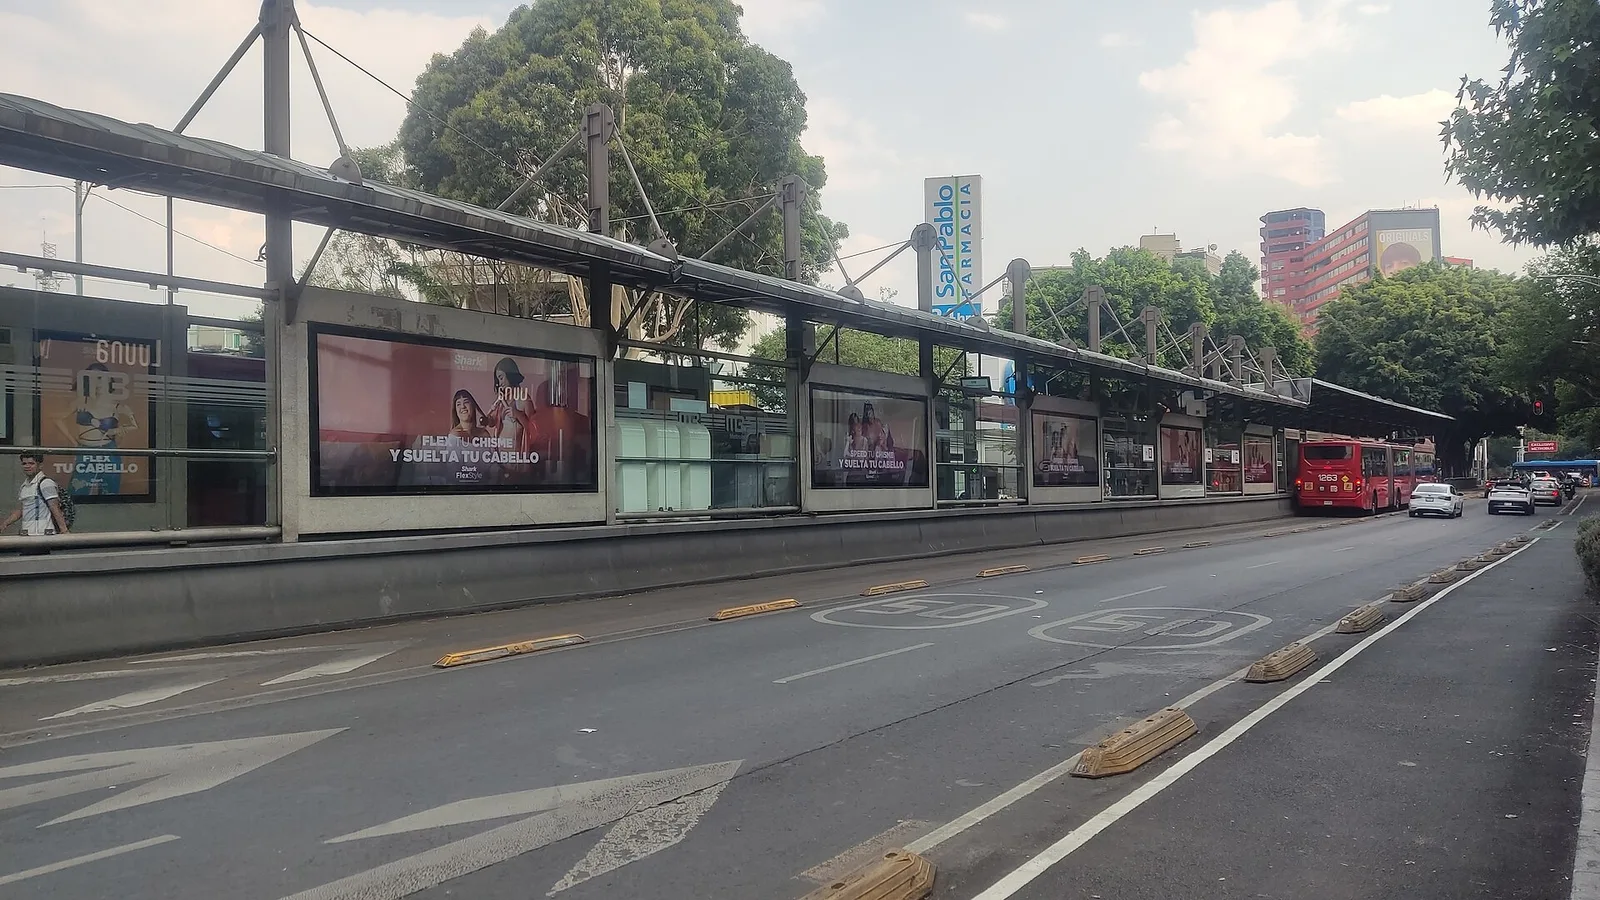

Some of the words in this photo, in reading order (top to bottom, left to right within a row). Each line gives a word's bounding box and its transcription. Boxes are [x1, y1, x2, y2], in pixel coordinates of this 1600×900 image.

[960, 183, 972, 297] FARMACIA
[1379, 231, 1430, 243] ORIGINALS
[454, 354, 482, 367] Shark
[422, 436, 453, 448] FLEX
[457, 437, 470, 448] TU
[471, 437, 514, 449] CHISME
[390, 449, 400, 461] Y
[402, 449, 460, 462] SUELTA
[461, 450, 480, 462] TU
[481, 451, 540, 464] CABELLO
[850, 449, 868, 458] SPEED
[53, 463, 74, 473] TU
[75, 463, 138, 473] CABELLO
[839, 459, 845, 468] Y
[844, 459, 869, 469] SUELTA
[869, 460, 878, 469] TU
[878, 460, 904, 470] CABELLO
[1064, 614, 1233, 638] 50
